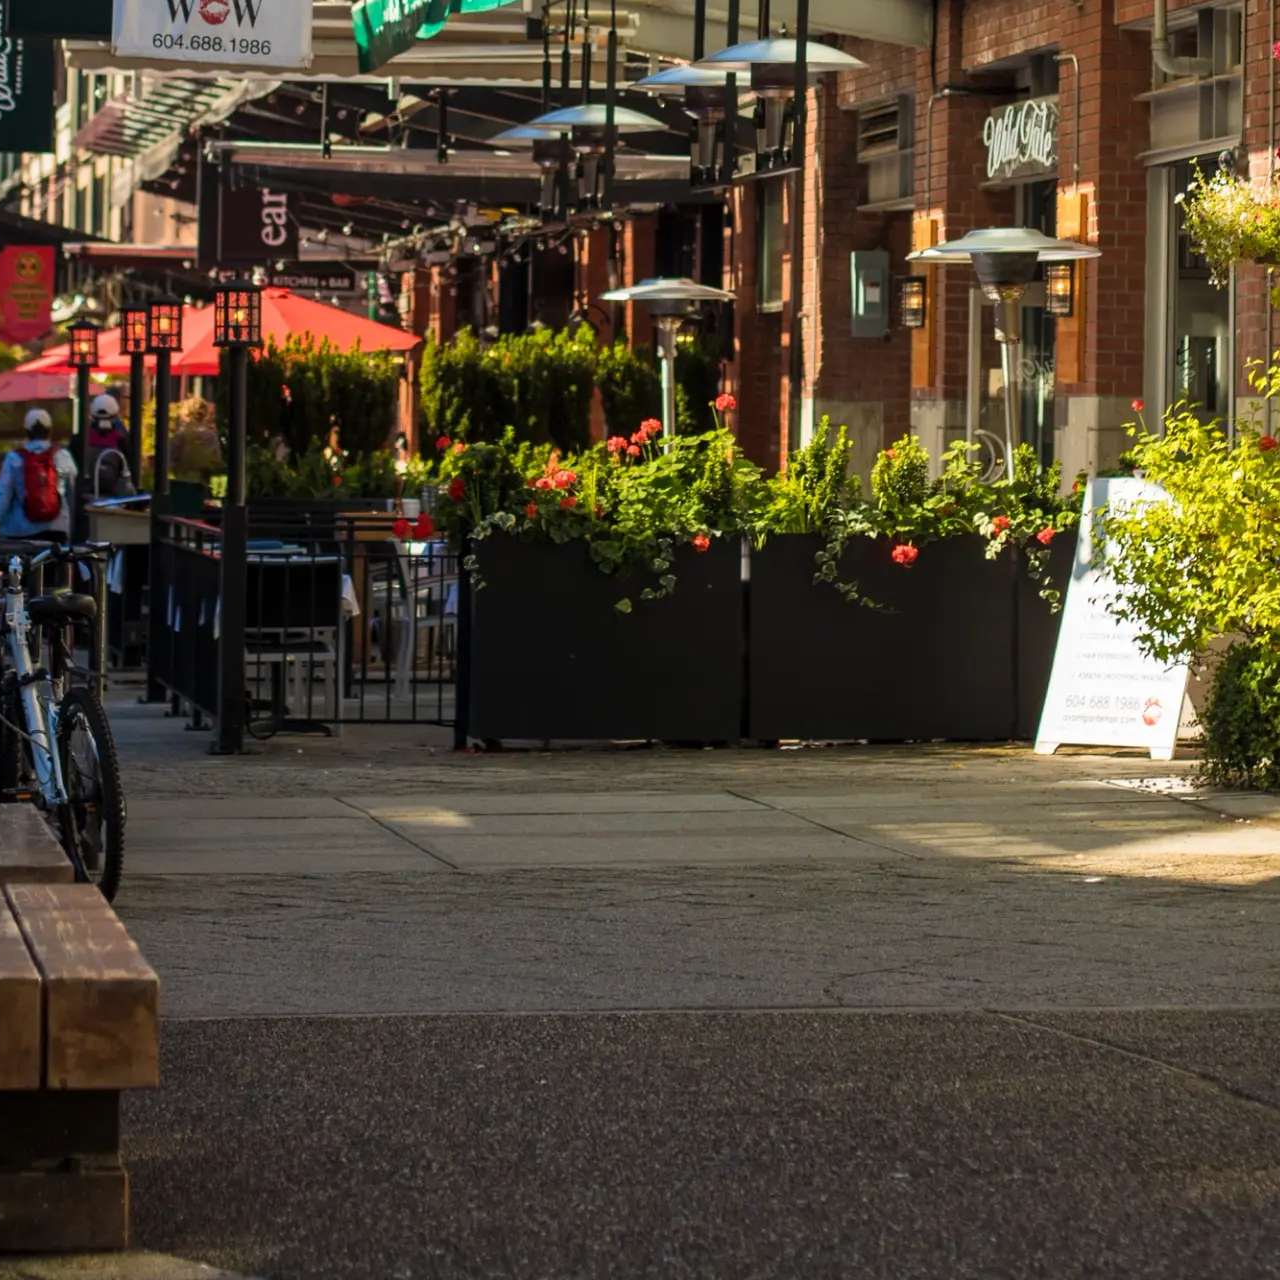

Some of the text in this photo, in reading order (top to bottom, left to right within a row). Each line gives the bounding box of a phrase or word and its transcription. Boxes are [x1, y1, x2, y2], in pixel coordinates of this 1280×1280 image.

[152, 33, 271, 55] 604.688.1986
[983, 100, 1052, 178] Wild Tale
[328, 278, 350, 288] BAR
